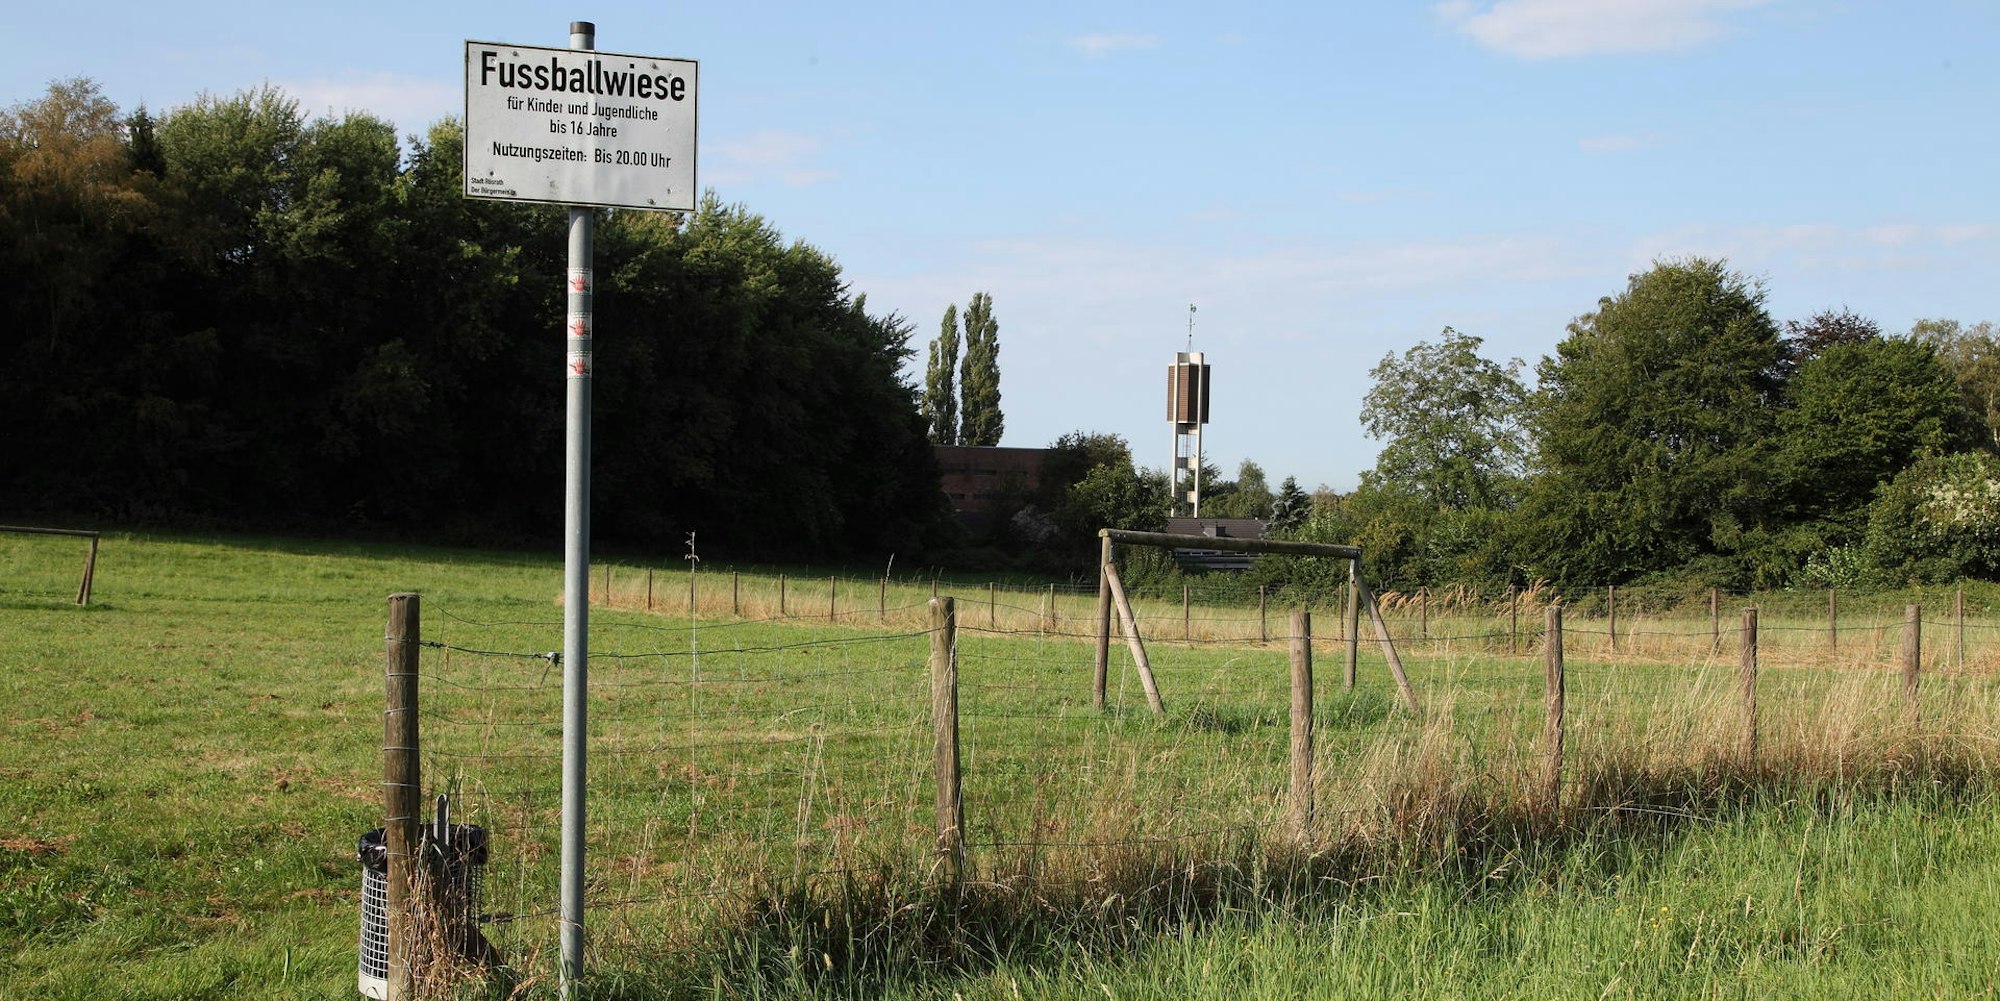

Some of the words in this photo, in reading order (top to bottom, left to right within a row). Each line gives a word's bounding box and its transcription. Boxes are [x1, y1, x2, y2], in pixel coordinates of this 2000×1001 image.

[481, 50, 686, 101] Fussballwiese
[507, 96, 524, 111] für
[527, 97, 563, 113] Kinder
[568, 101, 588, 115] und
[592, 102, 658, 121] Jugendliche
[550, 119, 566, 134] bis
[570, 121, 583, 135] 16
[586, 123, 618, 138] Jahre
[493, 141, 587, 162] Nutzungszeiten:
[594, 149, 612, 164] Bis
[616, 150, 647, 167] 20.00
[651, 152, 671, 168] Uhr
[471, 177, 484, 185] Stadt
